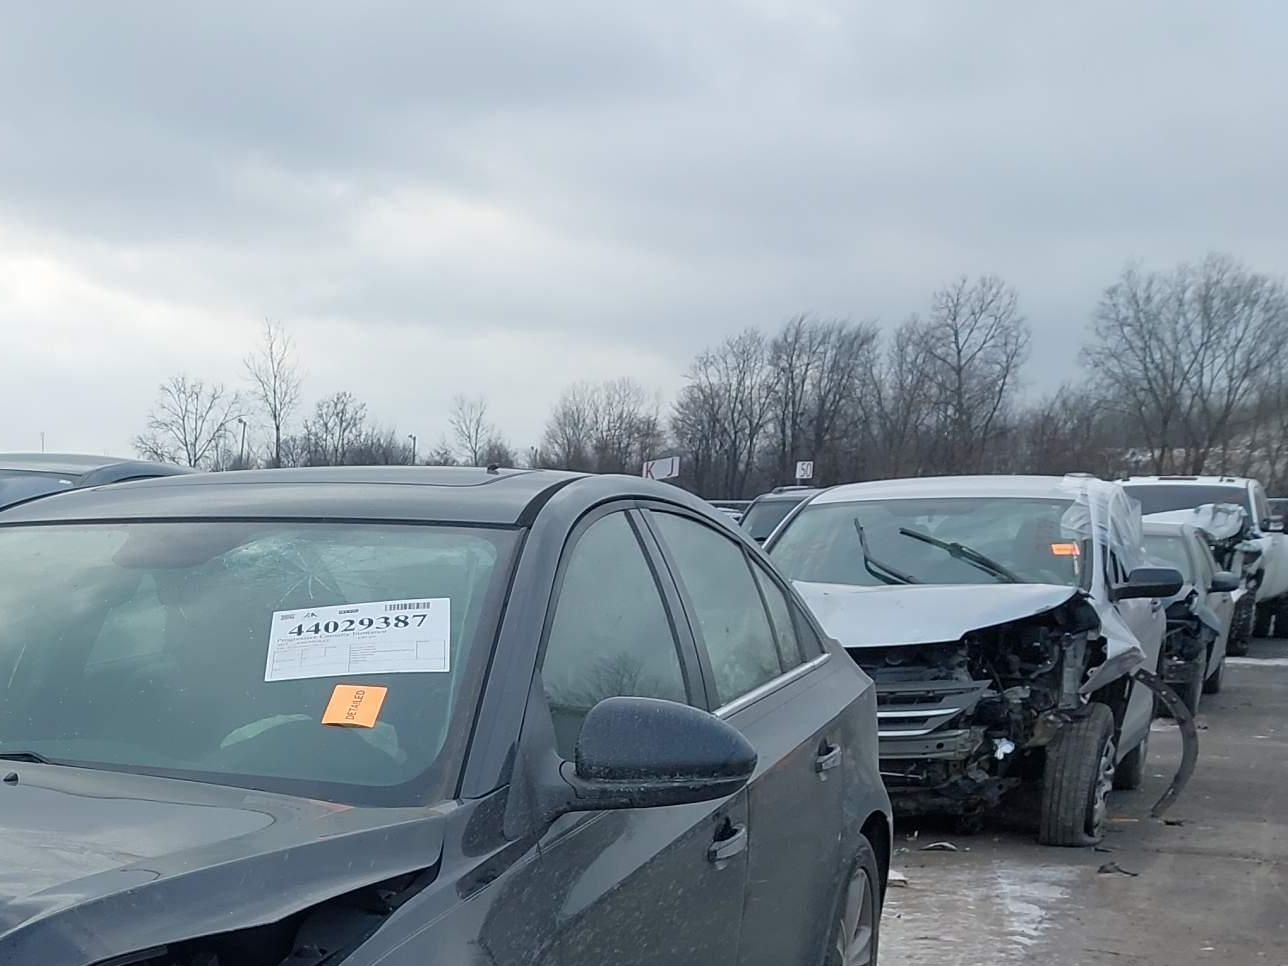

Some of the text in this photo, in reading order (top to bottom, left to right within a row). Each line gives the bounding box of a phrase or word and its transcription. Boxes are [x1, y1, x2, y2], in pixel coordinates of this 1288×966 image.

[645, 461, 656, 480] K
[288, 614, 427, 636] 44029387
[345, 689, 365, 720] DETAILED
